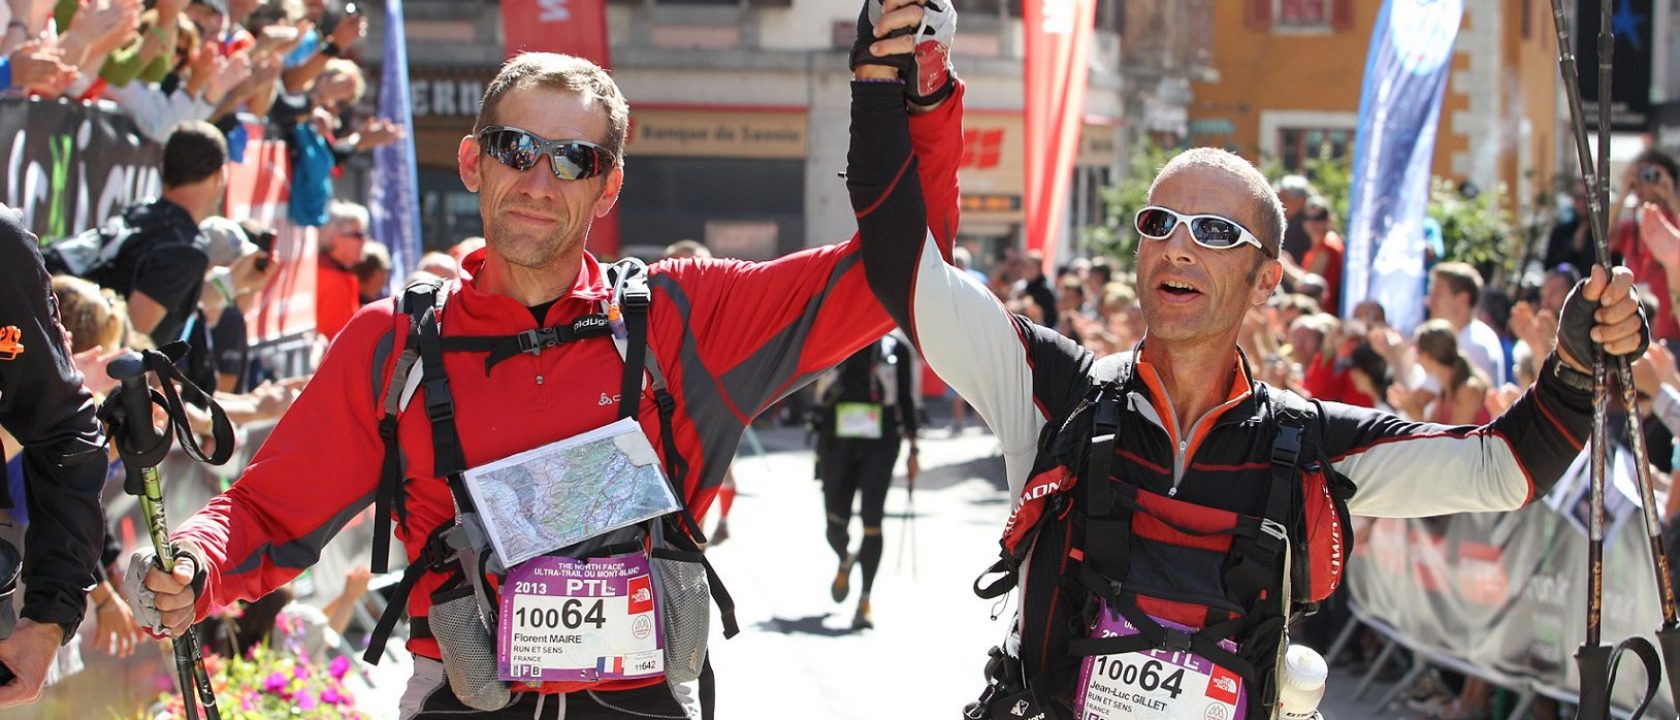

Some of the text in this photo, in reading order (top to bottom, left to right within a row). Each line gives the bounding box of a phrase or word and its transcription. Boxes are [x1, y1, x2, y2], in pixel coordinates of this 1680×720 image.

[713, 122, 735, 142] de
[534, 567, 582, 577] ULTRA-TRAIL
[584, 570, 596, 578] DU
[558, 562, 573, 571] THE
[515, 581, 547, 595] 2013
[515, 598, 607, 630] 10064
[514, 633, 582, 645] Florent MAIRE
[513, 645, 563, 655] RUN ET SENS
[513, 655, 541, 663] FRANCE
[1097, 655, 1185, 700] 10064
[1087, 691, 1133, 713] RUN ET SENS
[1090, 680, 1168, 713] Jean-Luc GILLET
